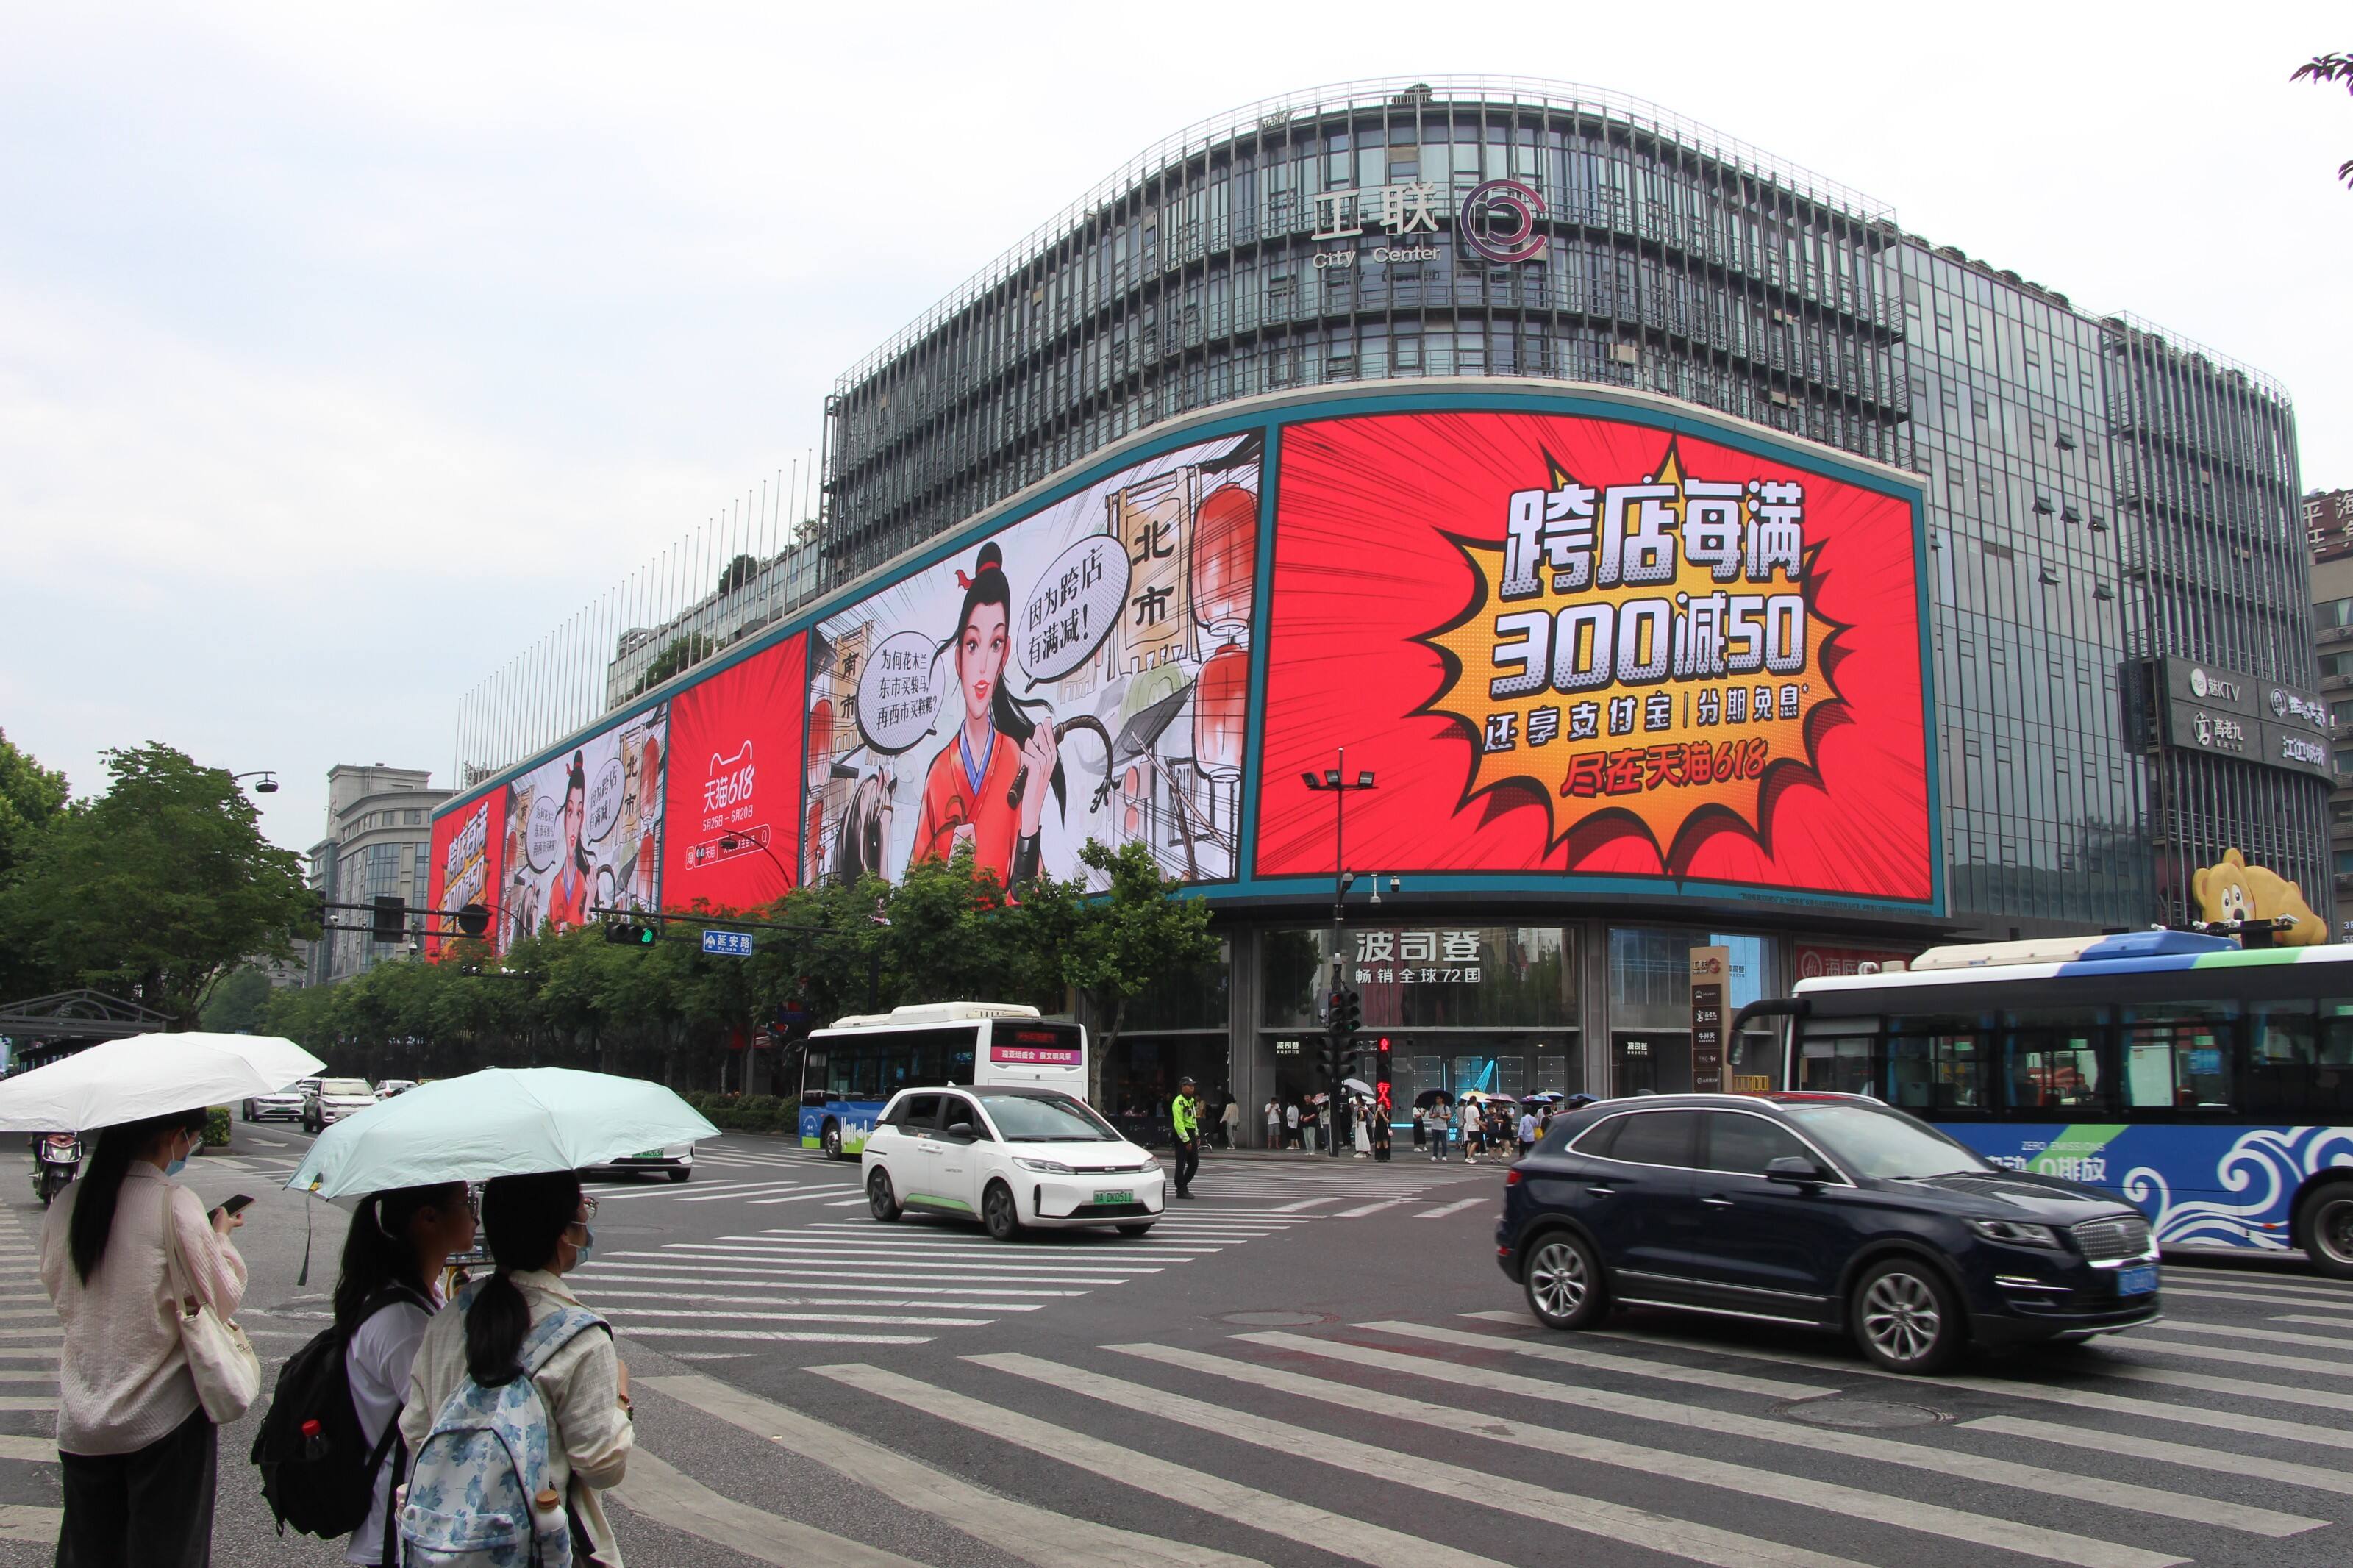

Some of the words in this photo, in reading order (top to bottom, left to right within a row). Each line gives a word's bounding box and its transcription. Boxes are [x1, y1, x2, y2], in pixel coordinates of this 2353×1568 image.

[1311, 182, 1439, 241] 工联
[1312, 250, 1356, 269] City
[1373, 246, 1441, 264] Center
[1500, 476, 1804, 598] 跨店每满
[1132, 520, 1175, 626] 北市
[1029, 544, 1103, 632] 因为跨店
[1490, 593, 1807, 697] 300减50
[881, 649, 927, 670] 为何花木兰
[2208, 677, 2240, 701] 魅KTV
[2214, 717, 2243, 741] 高老九
[1560, 737, 1768, 797] 尽在天猫618
[625, 755, 638, 816] 北市
[704, 764, 755, 814] 天猫618
[718, 934, 749, 948] 延安路
[1355, 931, 1480, 962] 波司登
[1355, 967, 1480, 984] 畅销全球72国
[1825, 958, 1871, 976] 海底
[1277, 1041, 1299, 1049] 波司登
[2021, 1141, 2046, 1150] ZERO
[2050, 1142, 2105, 1151] EMISSIONS
